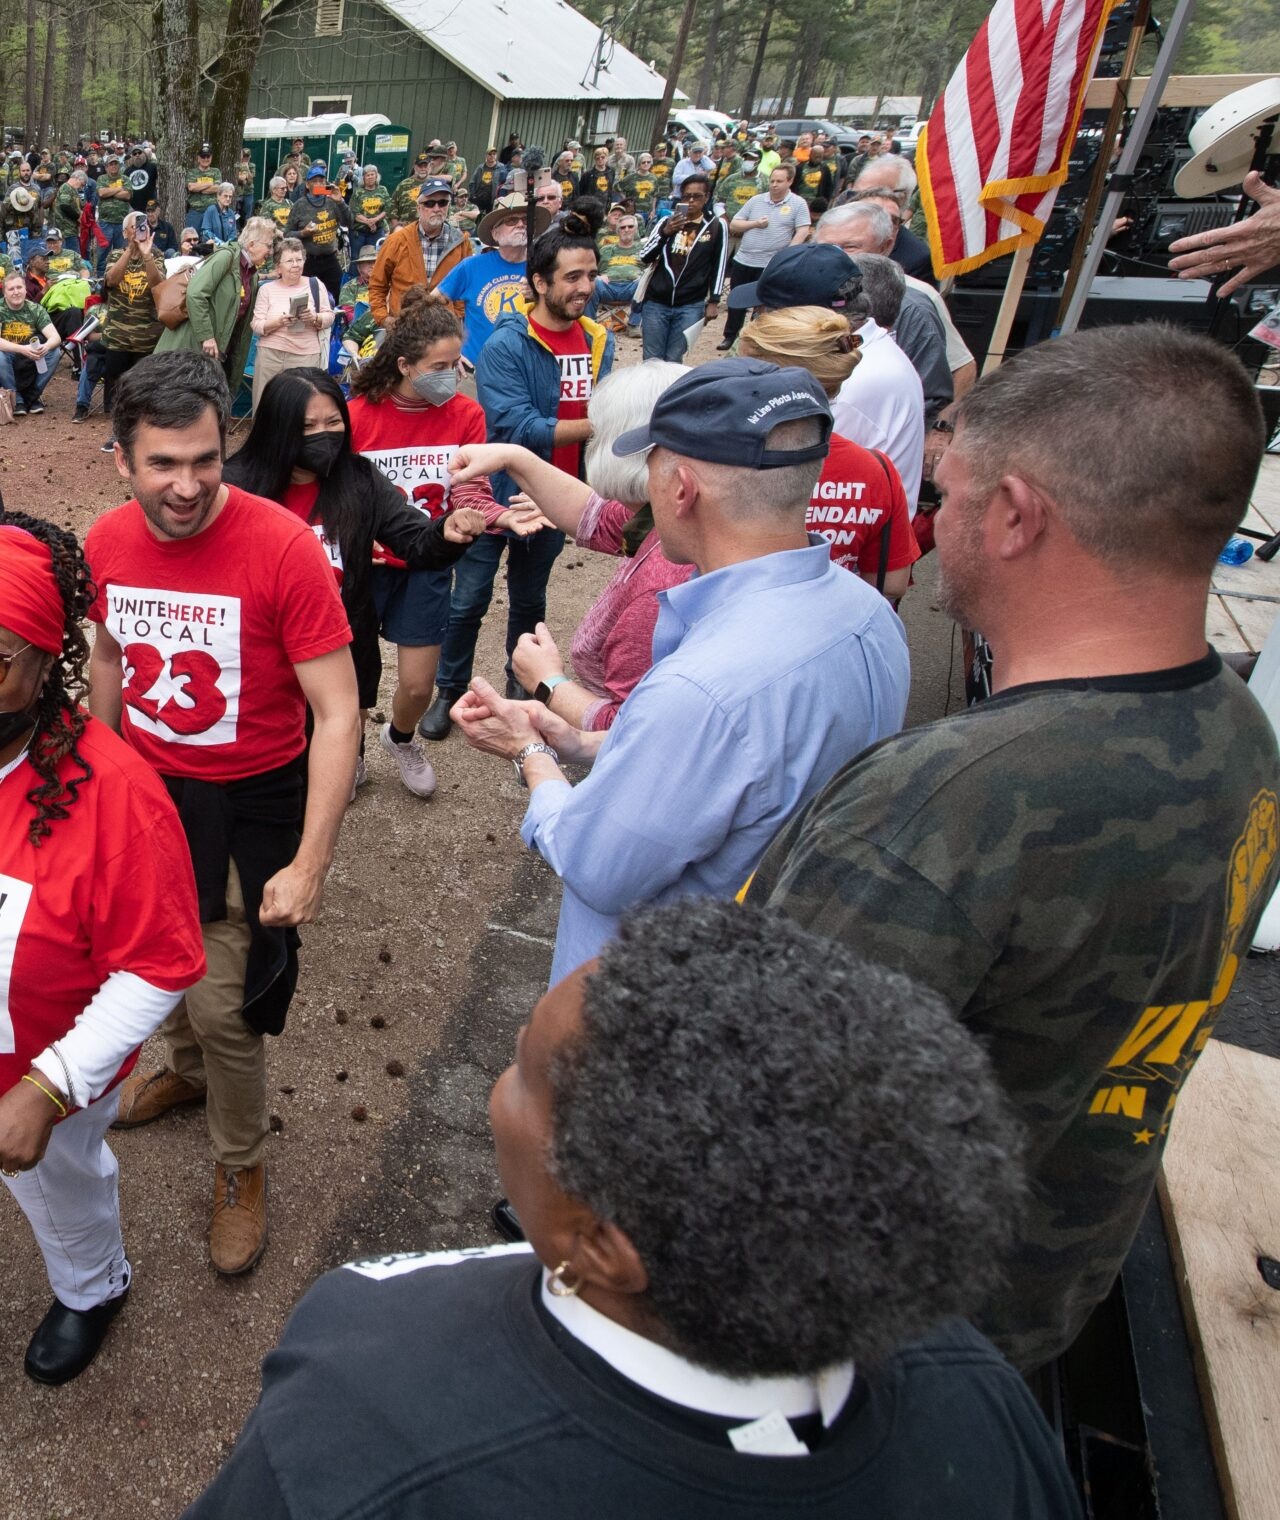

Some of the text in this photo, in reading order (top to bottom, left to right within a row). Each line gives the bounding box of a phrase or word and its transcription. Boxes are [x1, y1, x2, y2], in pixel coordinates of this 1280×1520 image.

[316, 219, 337, 230] ICTORY
[492, 275, 509, 284] CLUB
[559, 356, 593, 376] ITE
[560, 379, 593, 397] RE!
[747, 415, 760, 424] Air
[754, 405, 772, 418] Line
[768, 394, 792, 408] Pilots
[386, 467, 443, 481] OCAL
[812, 481, 866, 499] IGHT
[805, 506, 883, 524] ENDANT
[114, 597, 226, 627] UNITEHERE!
[120, 617, 213, 646] LOCAL
[122, 643, 227, 735] 23
